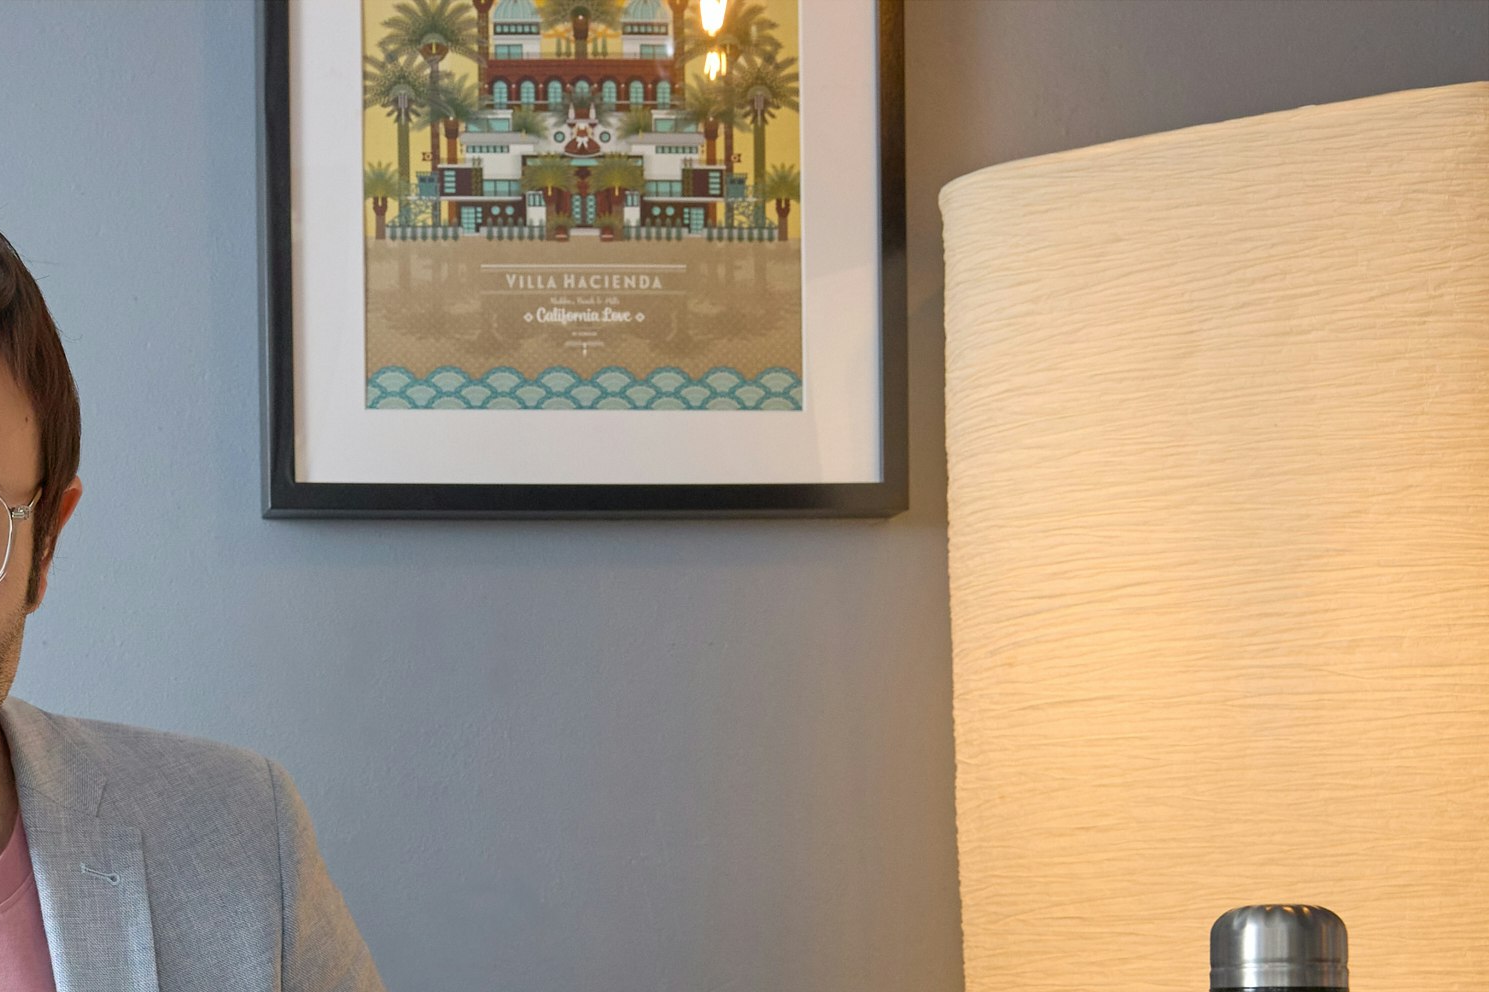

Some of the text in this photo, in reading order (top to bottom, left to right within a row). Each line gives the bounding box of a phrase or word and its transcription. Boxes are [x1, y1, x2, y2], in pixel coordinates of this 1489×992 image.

[506, 273, 662, 289] VILLA HACIENDA
[536, 307, 632, 325] California Love
